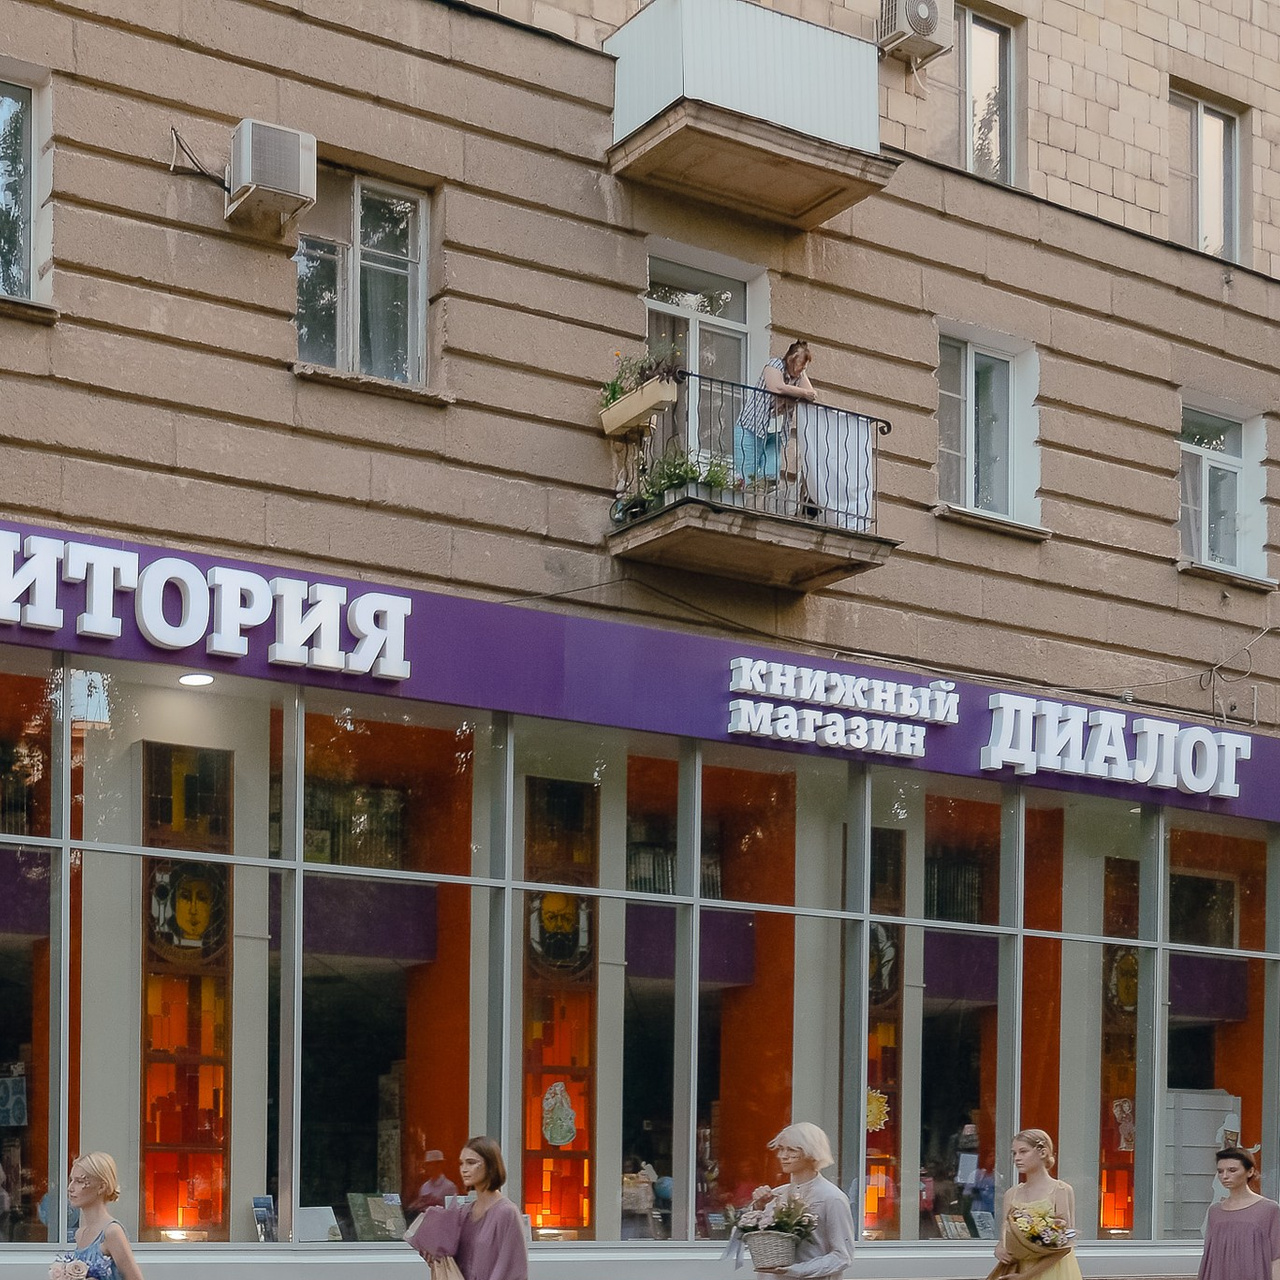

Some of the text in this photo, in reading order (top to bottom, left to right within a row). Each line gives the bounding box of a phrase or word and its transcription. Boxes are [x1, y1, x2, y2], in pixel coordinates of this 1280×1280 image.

[729, 656, 960, 725] книжный
[727, 698, 927, 759] магазин
[980, 692, 1252, 798] ДИАЛОГ
